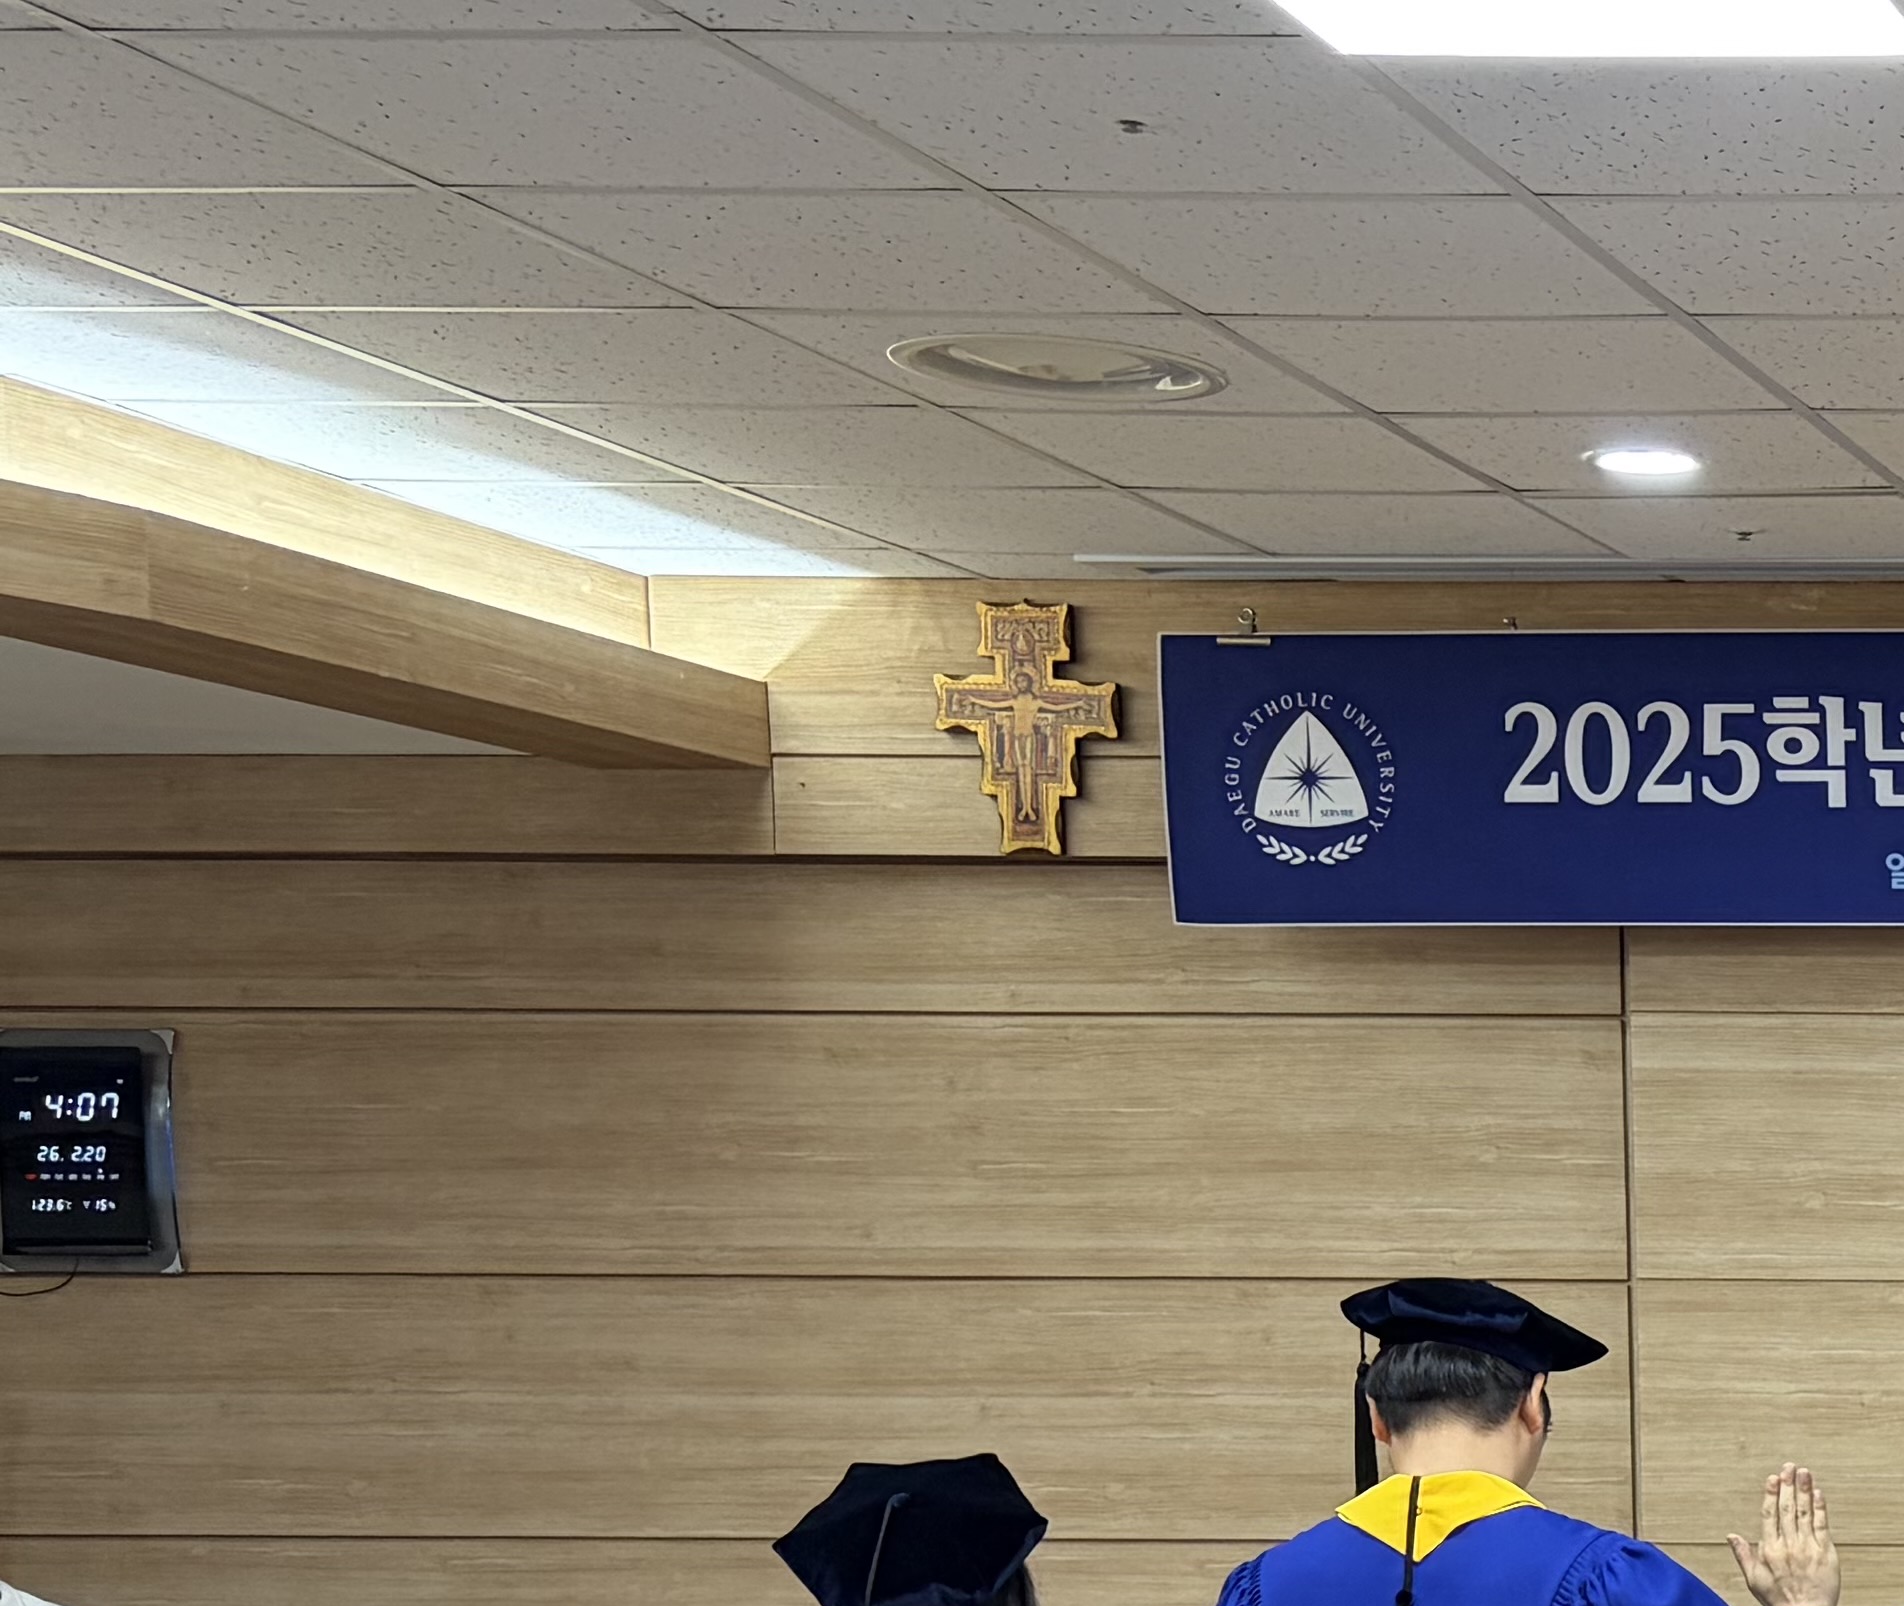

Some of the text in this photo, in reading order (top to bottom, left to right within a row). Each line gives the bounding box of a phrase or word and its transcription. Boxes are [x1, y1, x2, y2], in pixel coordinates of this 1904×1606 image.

[1224, 692, 1396, 834] DAEGU CATHOLIC UNIVERSITY
[45, 1092, 120, 1122] 4:07
